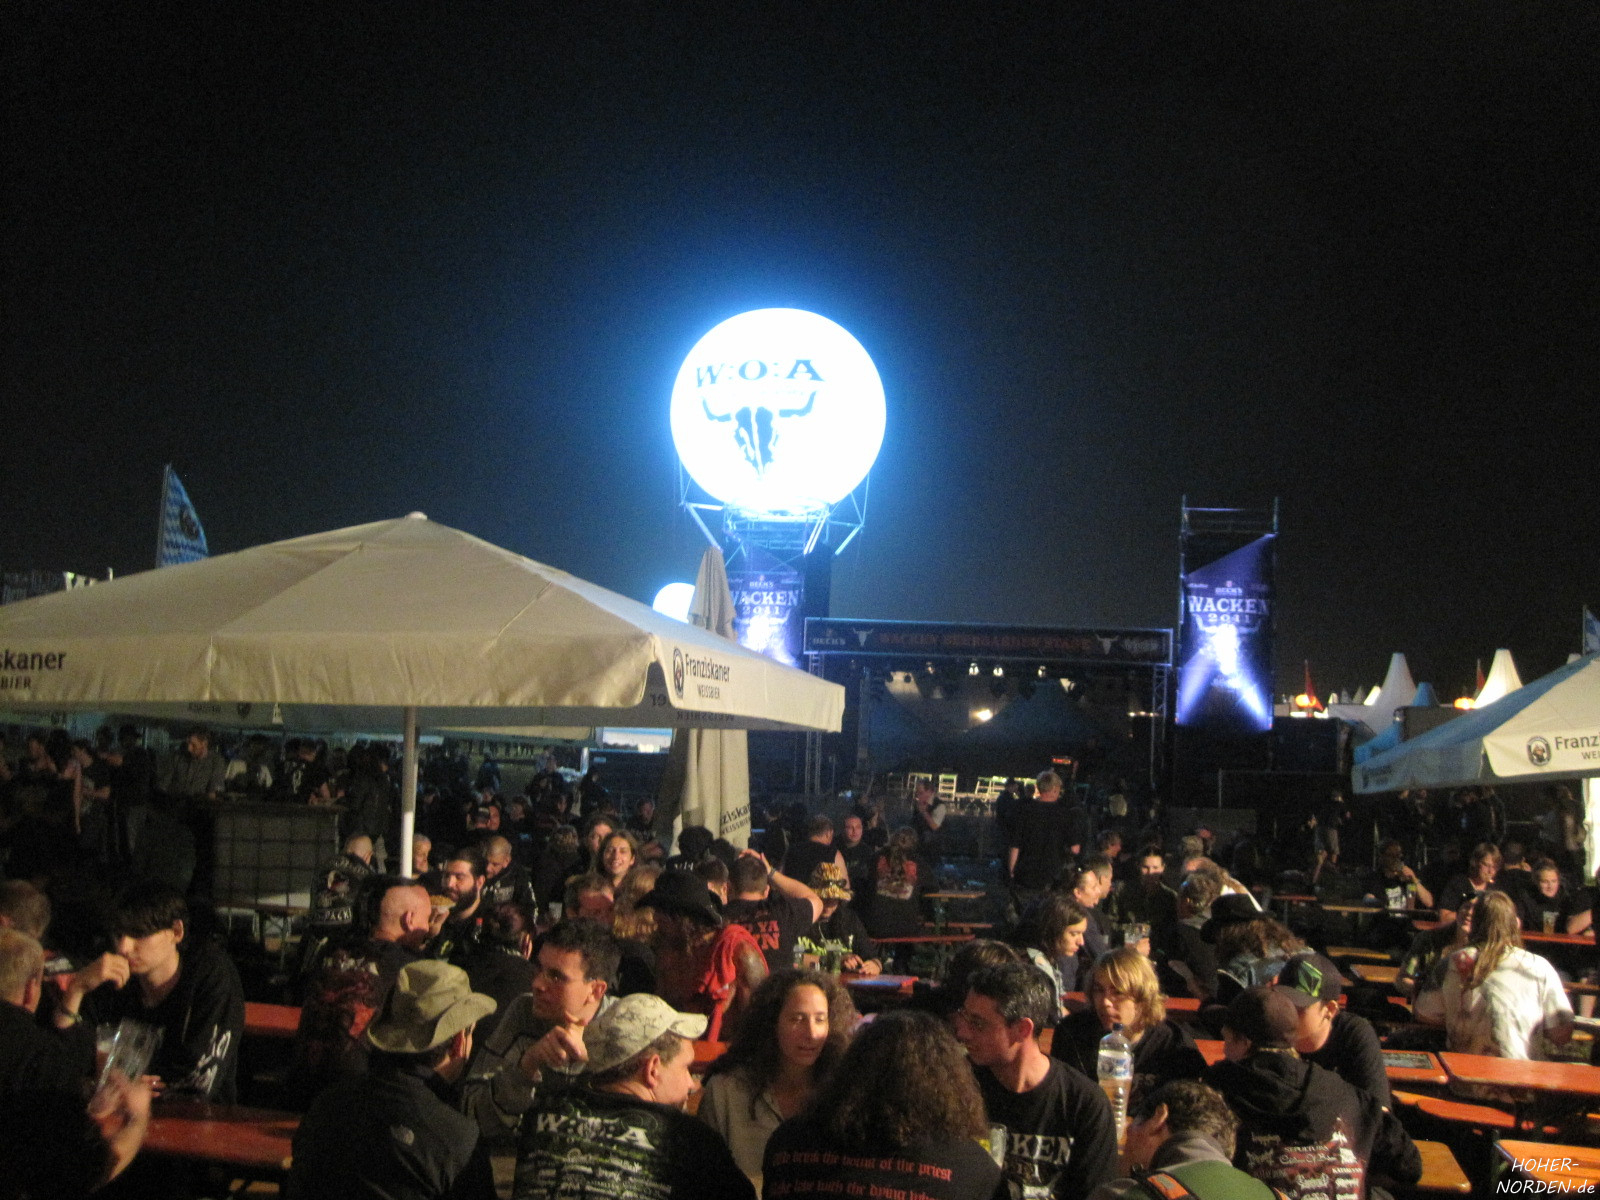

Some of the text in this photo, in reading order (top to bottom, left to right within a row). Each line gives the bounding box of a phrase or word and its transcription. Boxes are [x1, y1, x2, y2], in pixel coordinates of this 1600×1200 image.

[696, 359, 827, 388] W:O:A
[742, 606, 780, 615] 2011
[1188, 595, 1269, 616] WACKEN
[1208, 613, 1250, 624] 2011
[685, 653, 731, 683] Franziskaner
[697, 683, 721, 700] WEISSBIER
[879, 1158, 893, 1172] of
[896, 1159, 915, 1173] the
[918, 1163, 953, 1182] priest
